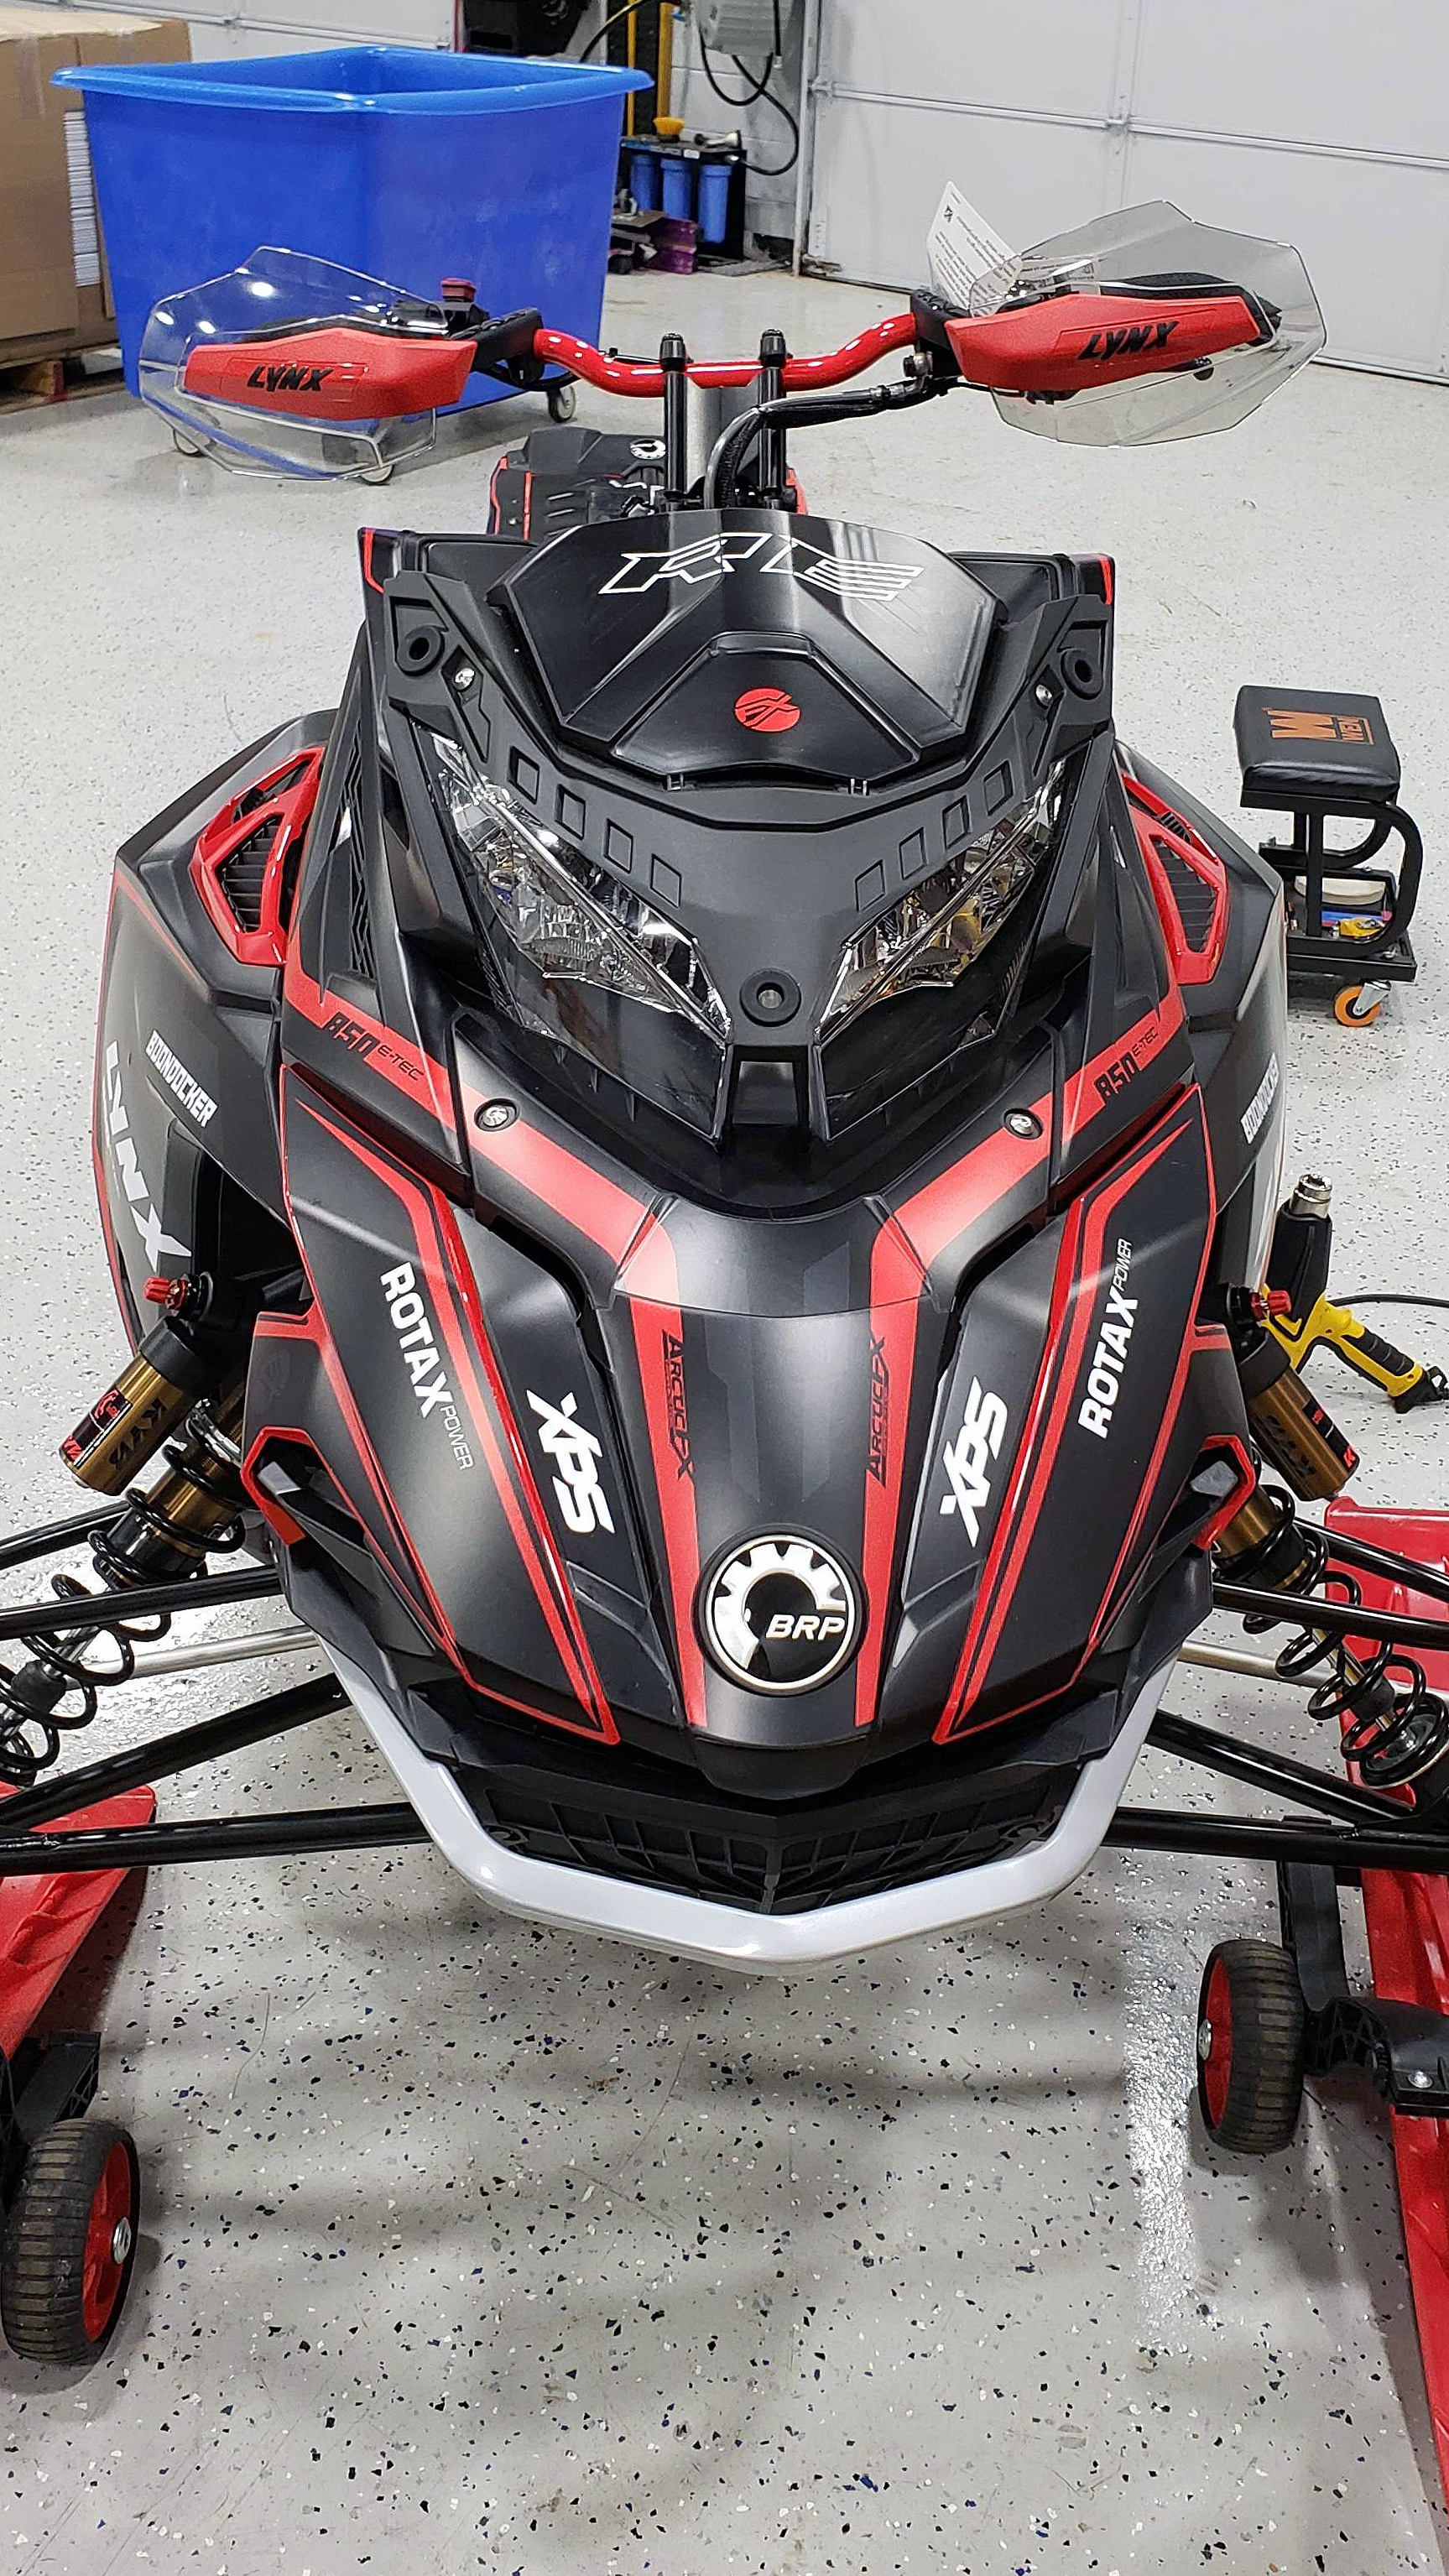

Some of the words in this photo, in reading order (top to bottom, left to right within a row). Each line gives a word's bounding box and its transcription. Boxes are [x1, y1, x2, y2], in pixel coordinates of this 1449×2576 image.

[247, 365, 333, 392] LYNX
[1077, 320, 1179, 360] LYNX
[145, 1030, 218, 1128] BOONDOCKER
[322, 1011, 381, 1060] 850
[378, 1045, 425, 1081] E-TEC
[1093, 1051, 1140, 1105] 850
[1131, 1026, 1159, 1056] E-TEC
[106, 1040, 192, 1272] LYNX
[380, 1261, 454, 1419] ROTAX
[440, 1405, 474, 1470] POWER
[1077, 1285, 1139, 1439] ROTAX
[1113, 1238, 1133, 1291] POWER
[526, 1389, 615, 1534] XPS
[939, 1375, 1009, 1548] XPS
[765, 1614, 846, 1641] BRP
